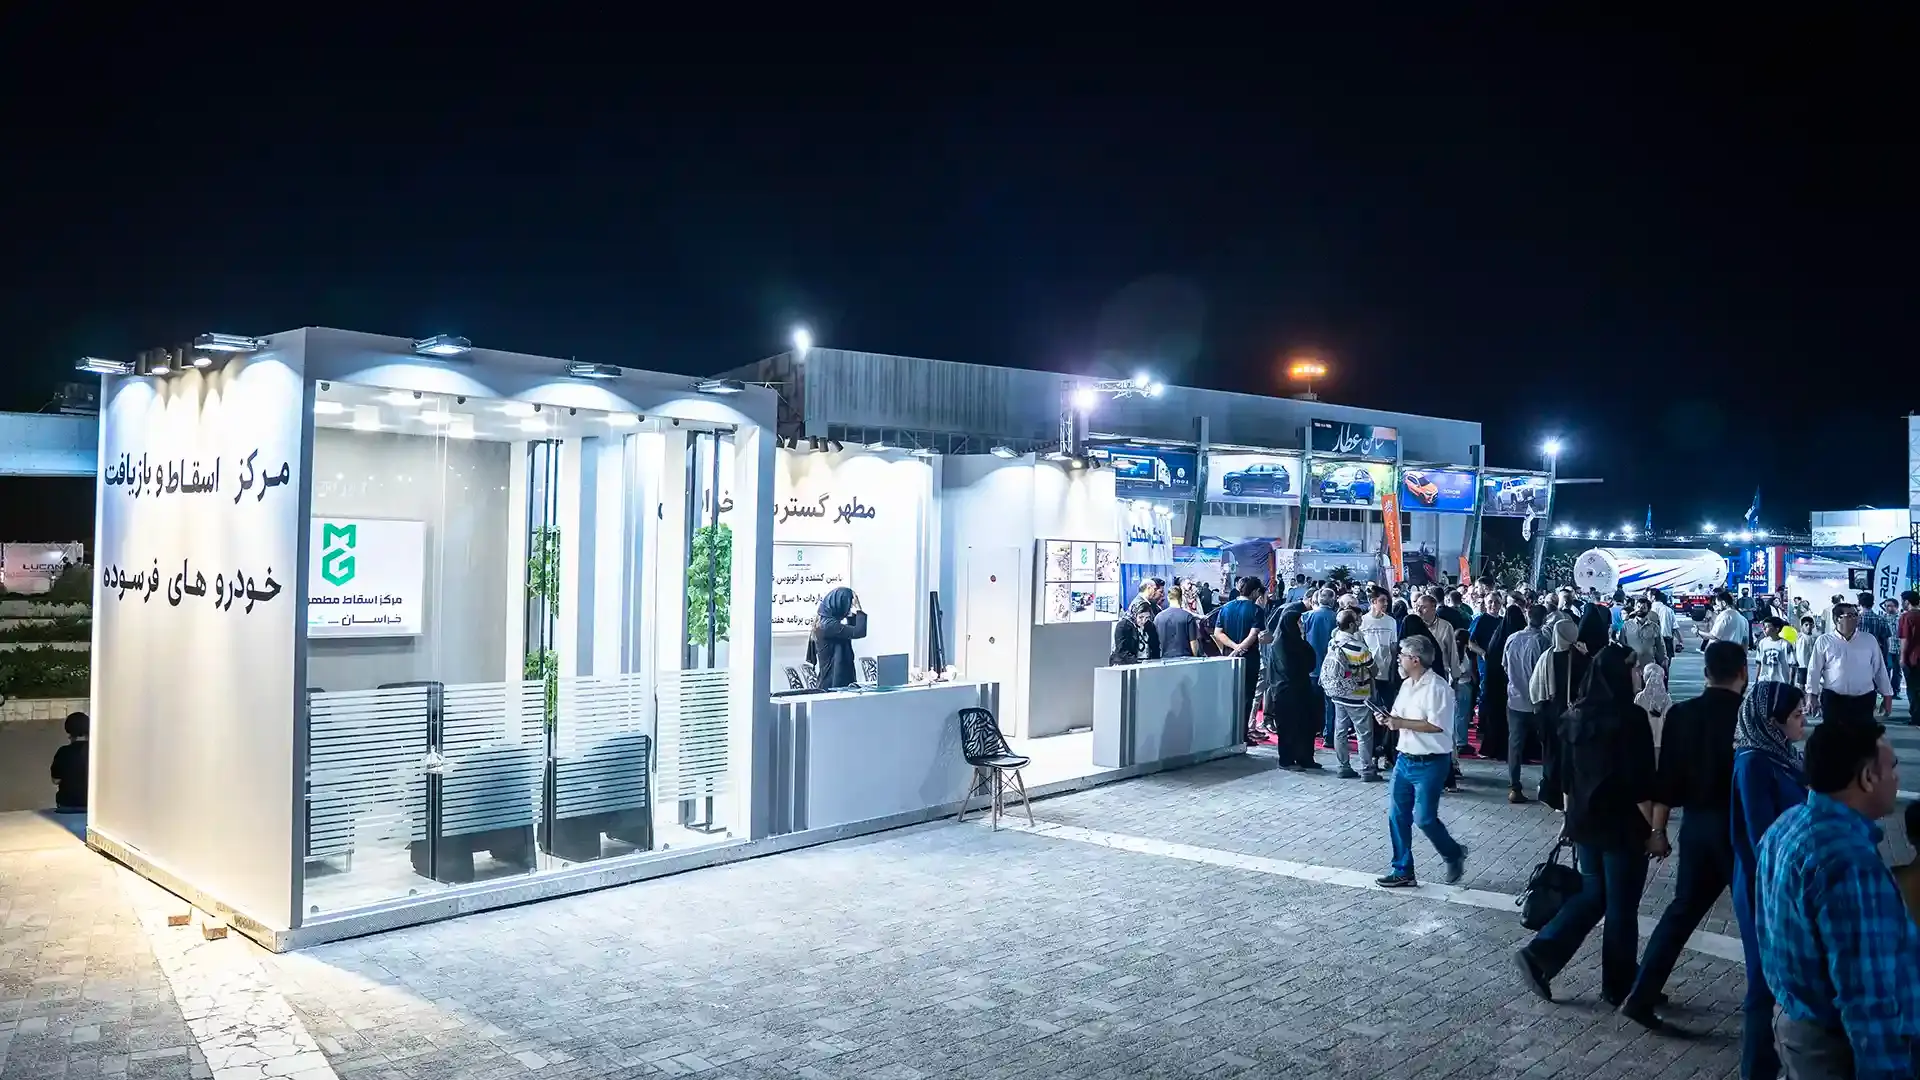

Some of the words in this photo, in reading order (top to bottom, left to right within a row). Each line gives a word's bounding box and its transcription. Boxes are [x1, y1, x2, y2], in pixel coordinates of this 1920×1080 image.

[1332, 424, 1362, 453] عطار
[105, 452, 151, 498] بازیافت
[156, 465, 163, 497] و
[165, 457, 220, 493] اسقاط
[234, 449, 289, 504] مرکز
[833, 496, 876, 524] مطهر
[103, 558, 159, 603] فرسوده
[168, 558, 207, 606] های
[215, 567, 282, 614] خودرو
[341, 594, 378, 605] اسقاط
[380, 594, 402, 605] مرکز
[778, 594, 795, 605] سال
[341, 614, 402, 627] خراسان
